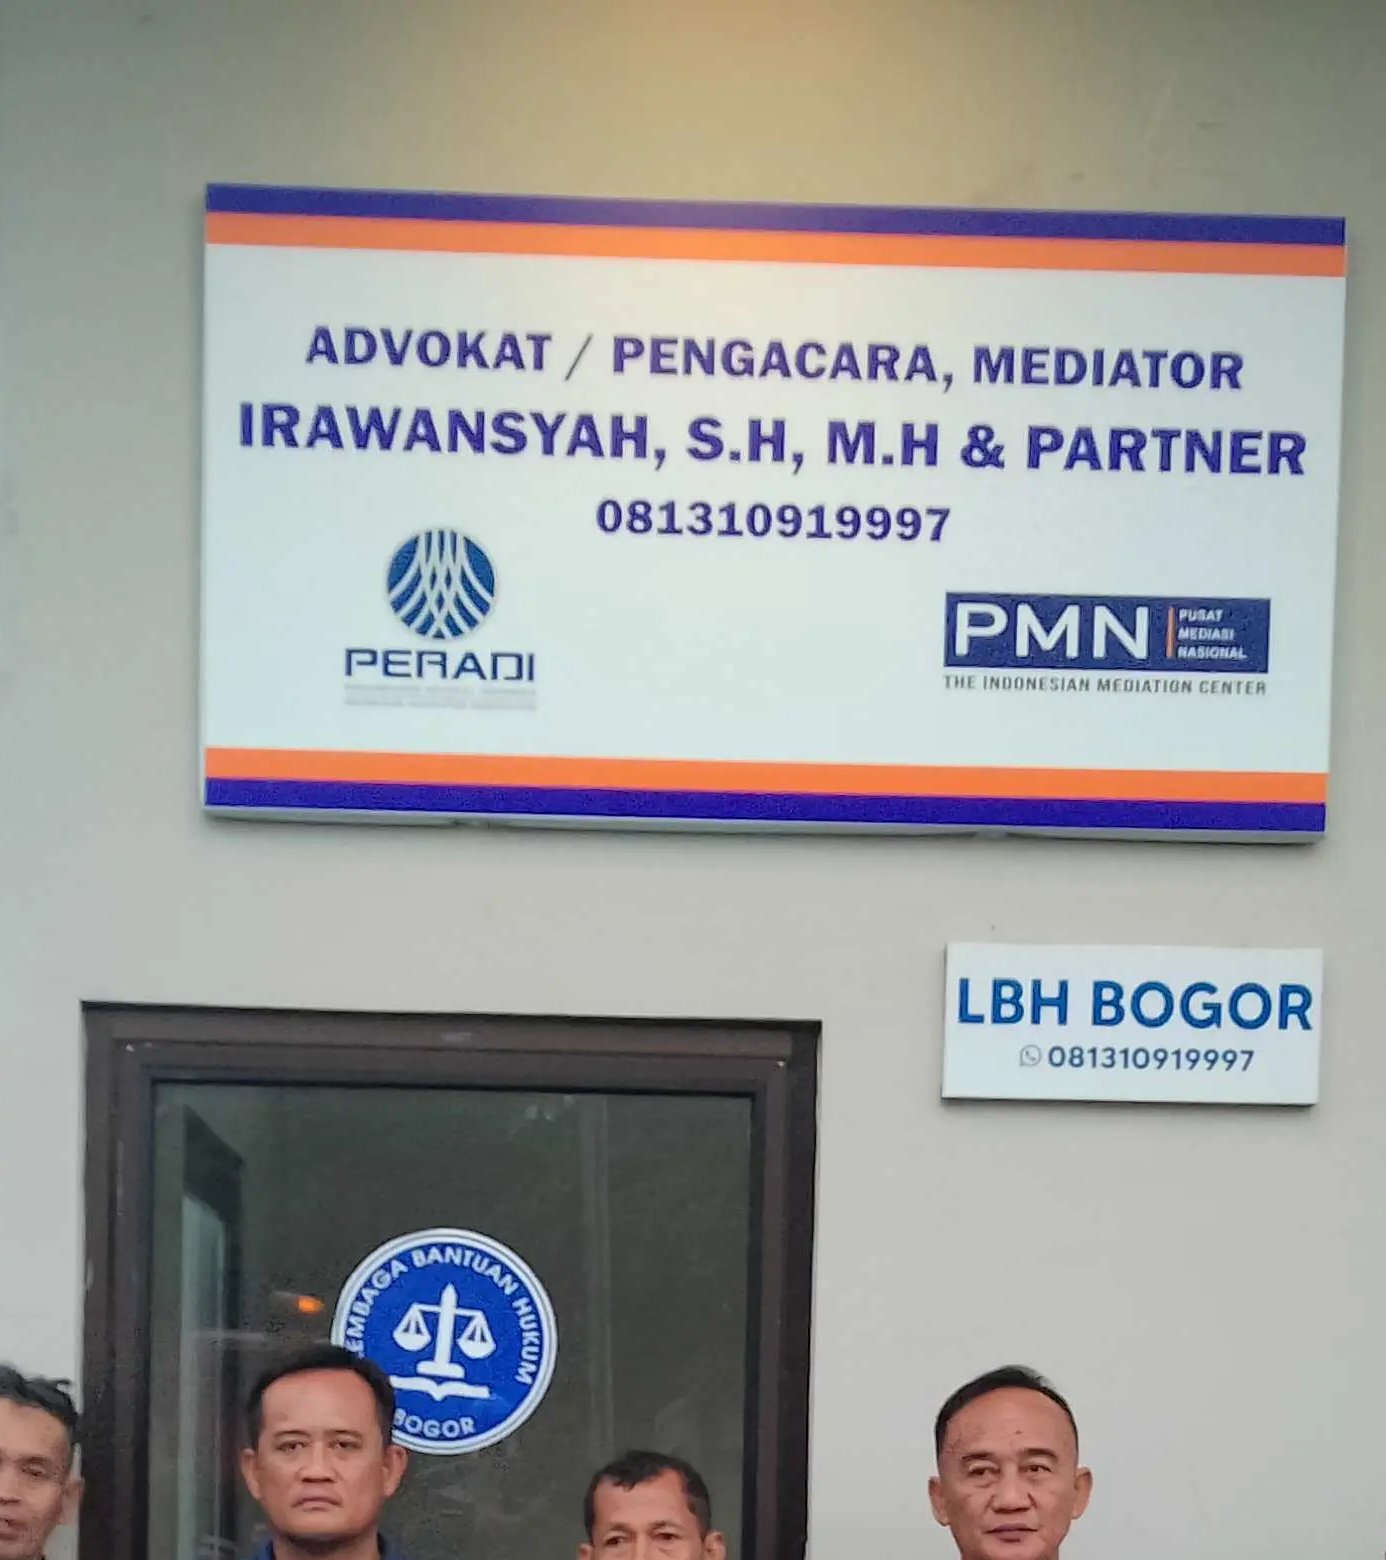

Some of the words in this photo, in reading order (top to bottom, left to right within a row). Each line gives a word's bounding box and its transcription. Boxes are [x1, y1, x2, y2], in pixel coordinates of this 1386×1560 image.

[305, 325, 552, 371] ADVOKAT
[565, 336, 592, 382] /
[613, 336, 953, 393] PENGACARA,
[973, 346, 1244, 390] MEDIATOR
[239, 401, 666, 471] IRAWANSYAH,
[687, 417, 804, 475] S.H,
[827, 420, 939, 467] M.H
[960, 423, 1006, 470] &
[1026, 425, 1307, 476] PARTNER
[596, 499, 950, 542] 081310919997
[954, 601, 1150, 660] PMN
[1178, 608, 1224, 622] PUSAT
[1177, 626, 1236, 641] MEDIASI
[344, 648, 535, 682] PERADI
[1177, 645, 1248, 660] NASIONAL
[945, 675, 976, 690] THE
[983, 676, 1090, 692] INDONESIAN
[1097, 677, 1193, 694] MEDIATION
[1199, 679, 1268, 695] CENTER
[957, 977, 1069, 1027] LBH
[1091, 979, 1313, 1031] BOGOR
[1048, 1045, 1255, 1072] 081310919997
[344, 1259, 409, 1359] EMBAGA
[411, 1246, 519, 1296] BANTUAN
[512, 1298, 542, 1386] HUKUM
[394, 1407, 476, 1438] BOGOR
